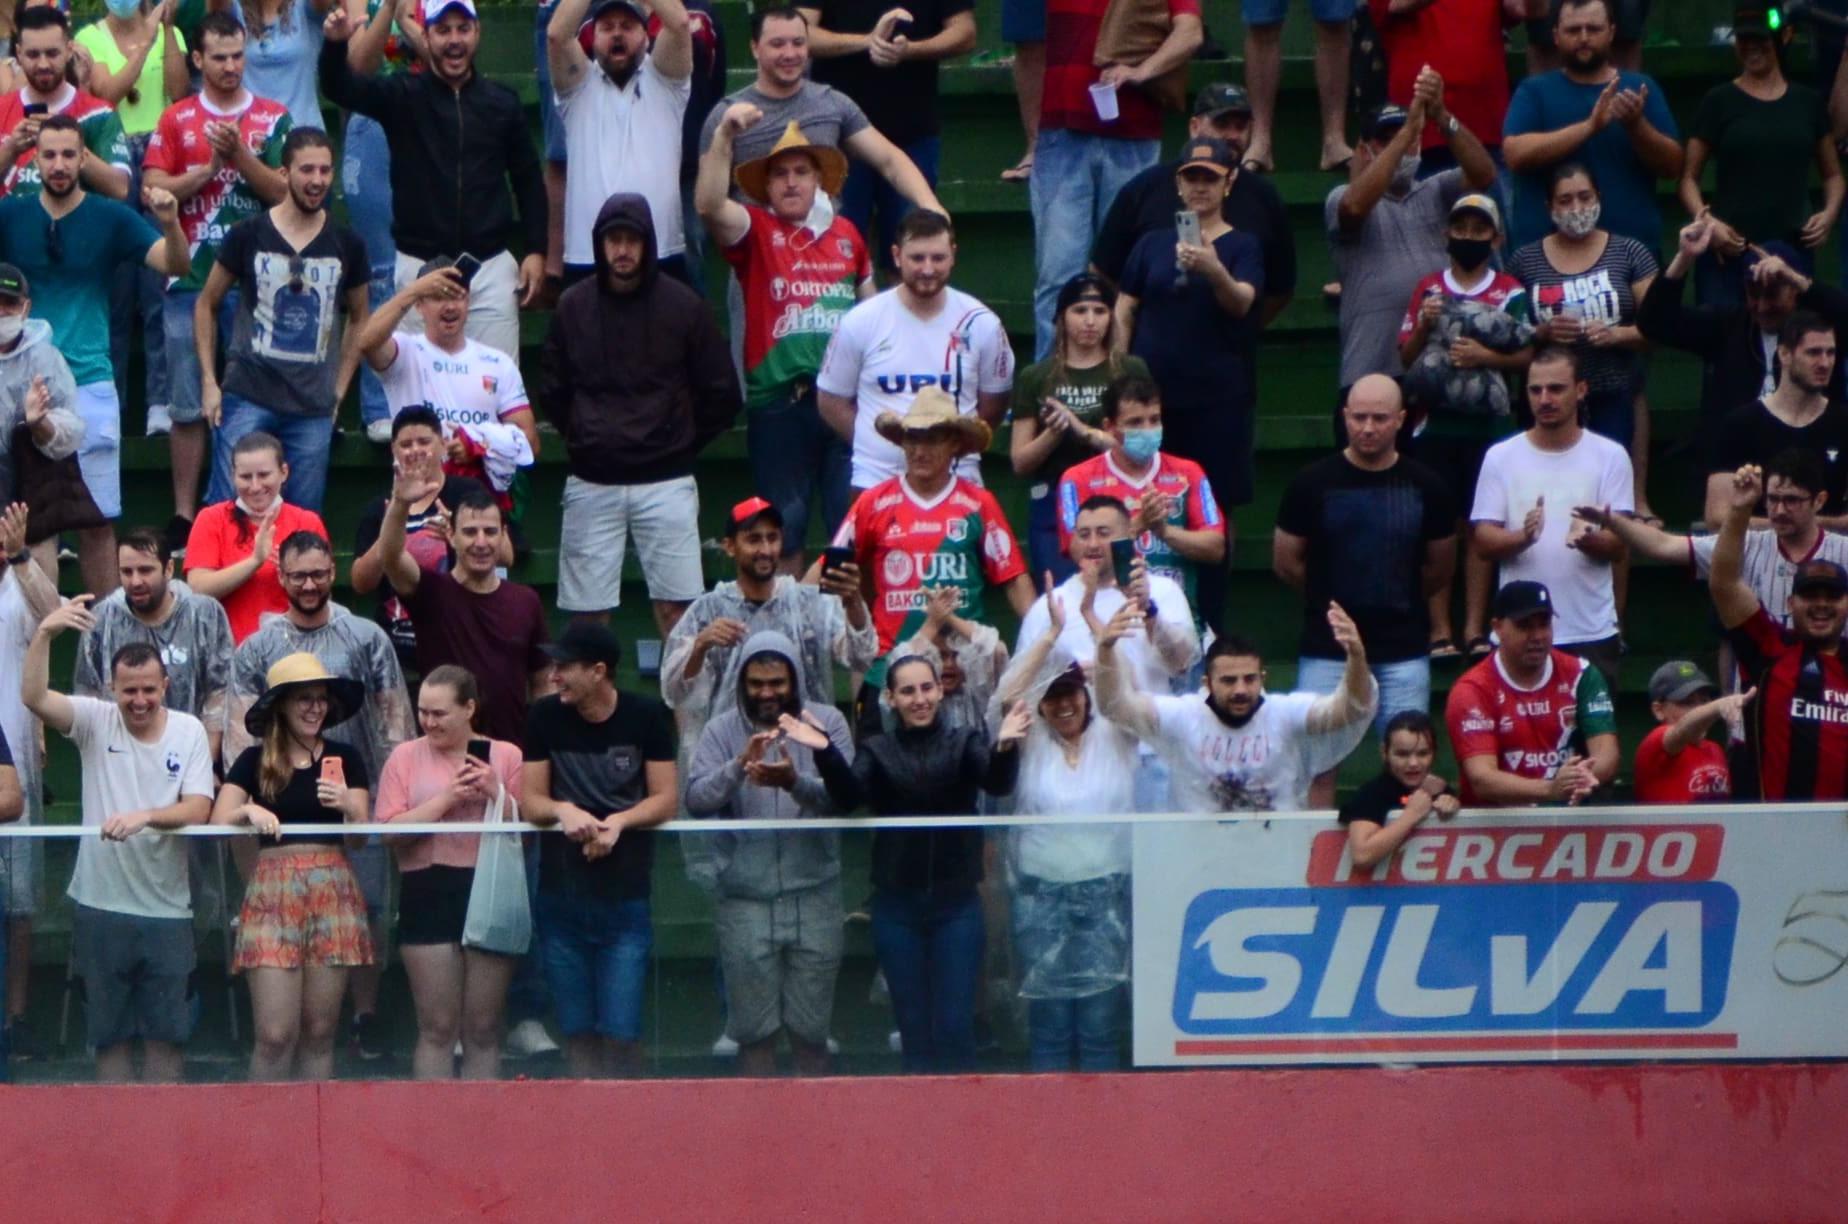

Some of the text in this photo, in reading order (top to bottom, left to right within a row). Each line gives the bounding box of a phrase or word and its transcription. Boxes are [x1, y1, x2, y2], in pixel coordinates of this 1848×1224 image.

[771, 303, 844, 338] Arba
[444, 362, 470, 375] URI
[913, 551, 969, 581] URI
[1527, 701, 1550, 716] URI
[1525, 749, 1573, 768] SICOO
[1189, 901, 1704, 1020] SILVA
